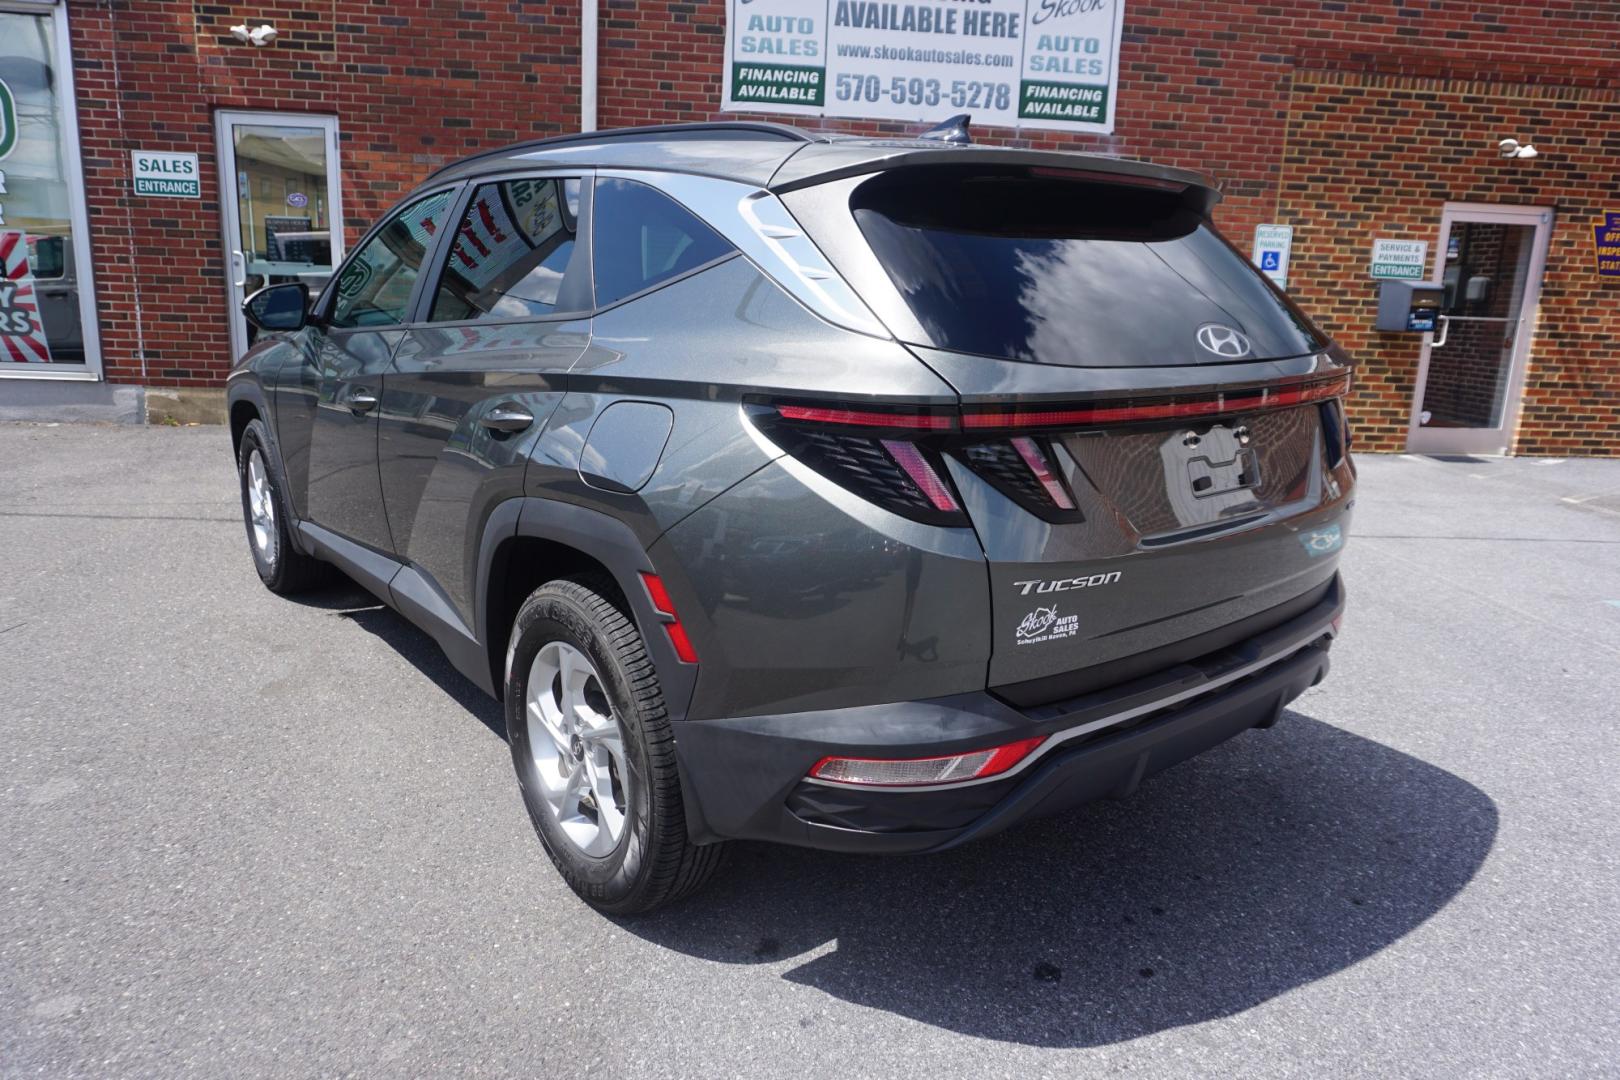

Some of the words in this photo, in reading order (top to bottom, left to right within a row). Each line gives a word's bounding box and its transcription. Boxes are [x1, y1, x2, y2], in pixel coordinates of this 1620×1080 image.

[747, 14, 815, 35] AUTO
[834, 1, 958, 35] AVAILABLE
[963, 9, 1020, 38] HERE
[740, 35, 819, 57] SALES
[1037, 34, 1100, 54] AUTO
[836, 43, 1014, 68] www.skookautosales.com
[1029, 54, 1104, 76] SALES
[739, 67, 820, 85] FINANCING
[738, 84, 817, 101] AVAILABLE
[835, 72, 1011, 111] 570-593-5278
[1026, 85, 1103, 103] FINANCING
[1024, 101, 1100, 118] AVAILABLE
[138, 158, 193, 174] SALES
[138, 180, 197, 194] ENTRANCE
[1380, 243, 1414, 252] SERVICE
[1378, 253, 1420, 263] PAYMENTS
[1374, 264, 1421, 277] ENTRANCE
[1053, 622, 1079, 634] SALES
[1056, 615, 1078, 625] AUTO
